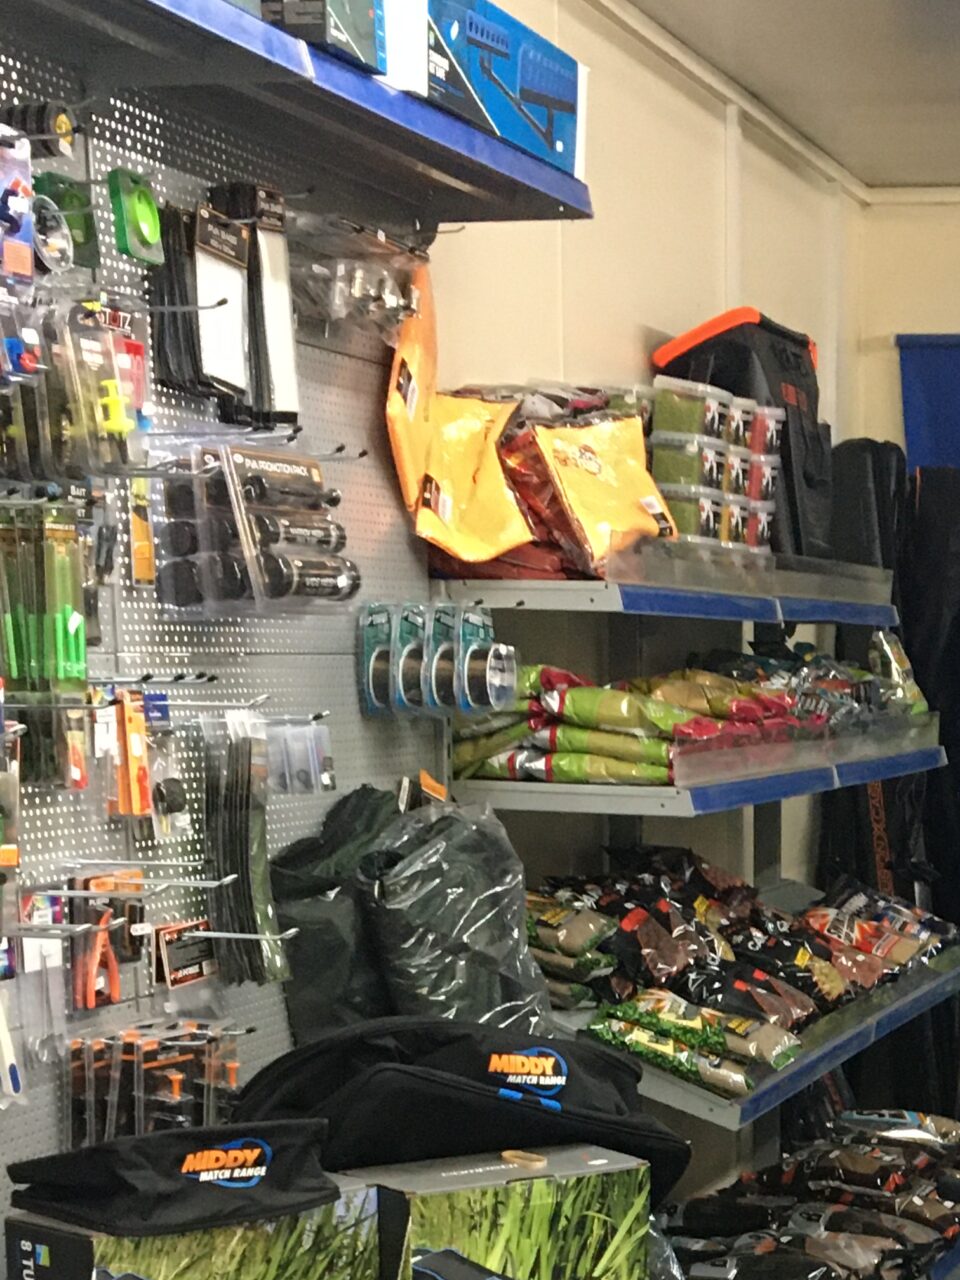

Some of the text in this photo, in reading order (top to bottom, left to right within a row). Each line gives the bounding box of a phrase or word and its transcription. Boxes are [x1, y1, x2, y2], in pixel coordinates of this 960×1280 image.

[488, 1053, 556, 1076] MIDDY
[506, 1074, 567, 1086] MATCH RANGE
[181, 1147, 262, 1174] MIDDY
[199, 1165, 268, 1183] MATCH RANGE
[20, 1239, 33, 1252] 8
